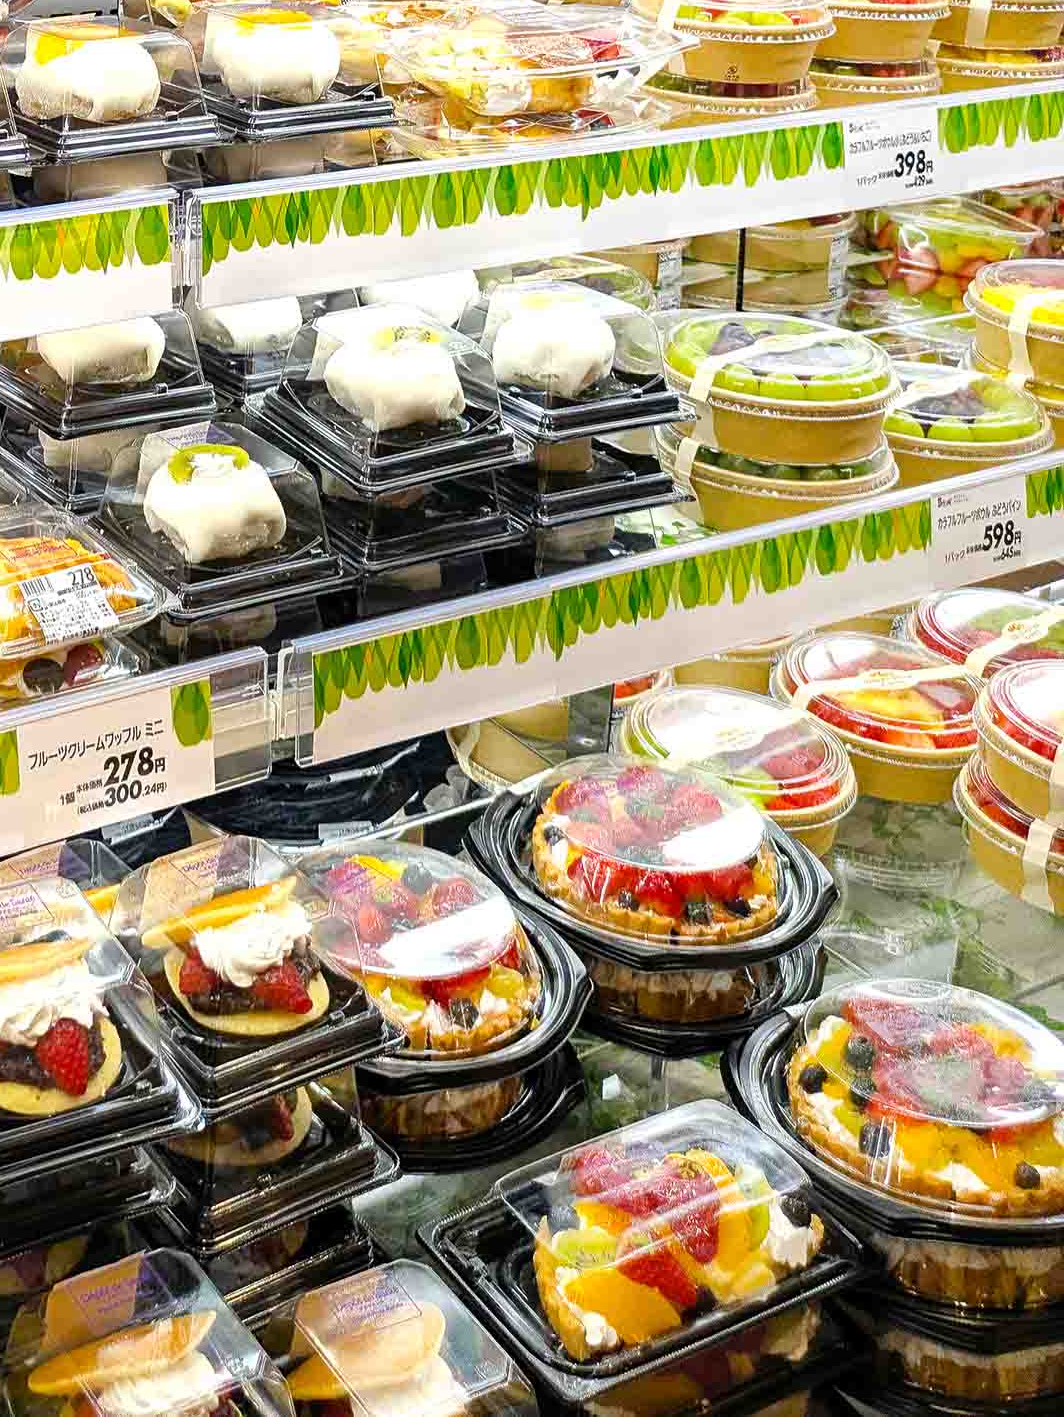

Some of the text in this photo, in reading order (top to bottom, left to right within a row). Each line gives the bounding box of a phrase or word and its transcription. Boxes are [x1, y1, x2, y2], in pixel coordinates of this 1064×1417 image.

[72, 566, 95, 587] 278
[28, 719, 165, 770] フルーツクリームワッフル ミニ
[59, 790, 76, 806] 1個
